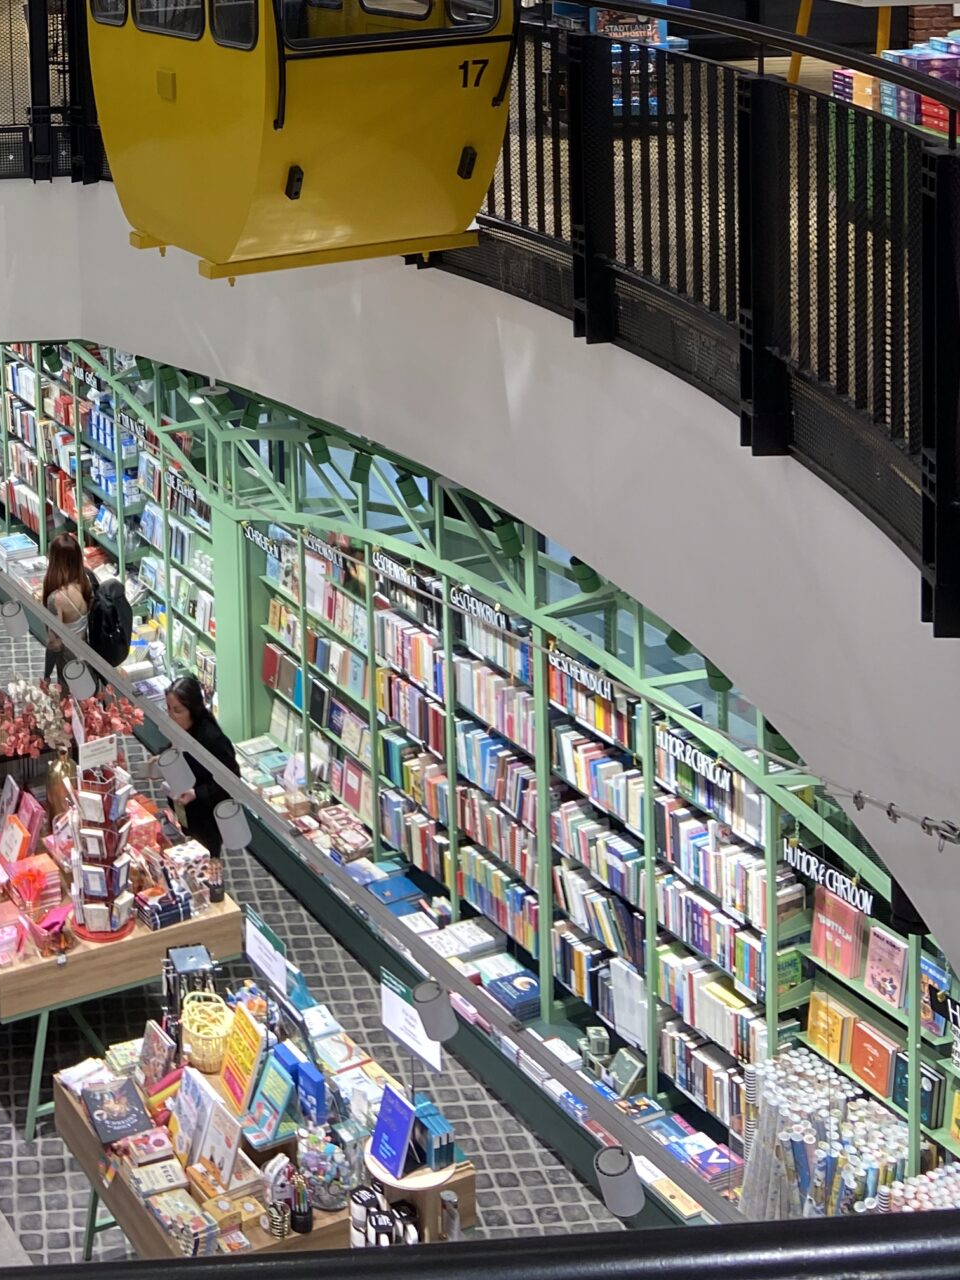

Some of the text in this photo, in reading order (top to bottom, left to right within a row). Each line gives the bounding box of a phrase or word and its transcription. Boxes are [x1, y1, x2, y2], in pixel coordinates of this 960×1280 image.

[458, 58, 489, 88] 17
[372, 551, 418, 589] GESCHENKBUCH
[450, 587, 506, 630] GESCHENKBUCH
[656, 729, 731, 792] HUMOR & CARTOON
[783, 838, 874, 915] HUMOR & CARTOON
